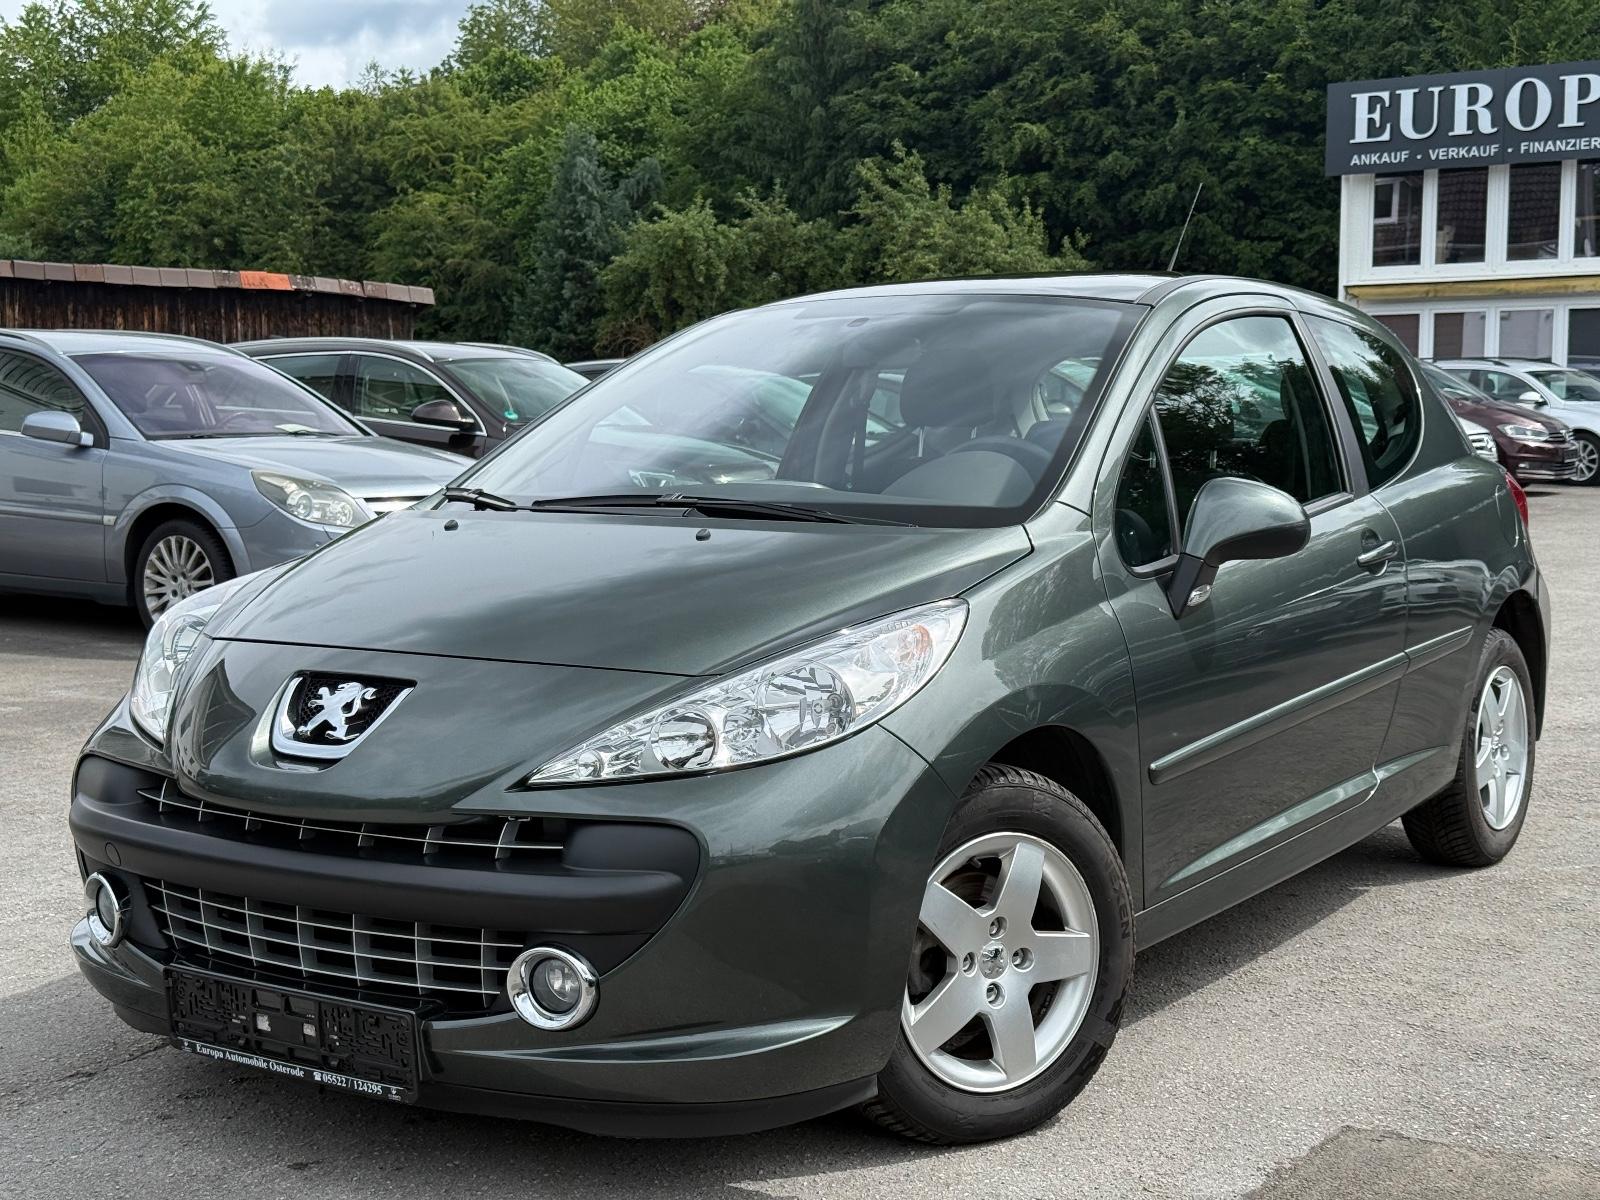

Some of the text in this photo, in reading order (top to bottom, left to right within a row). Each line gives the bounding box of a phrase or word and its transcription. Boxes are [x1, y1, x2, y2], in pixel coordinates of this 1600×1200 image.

[1349, 74, 1600, 144] EUROP
[1350, 138, 1600, 166] ANKAUF VERKAUF FINANZIER
[196, 1044, 224, 1059] Europa
[225, 1051, 268, 1070] Automobile
[269, 1061, 305, 1078] Osterode
[322, 1073, 347, 1087] 05522
[353, 1080, 383, 1095] 124295
